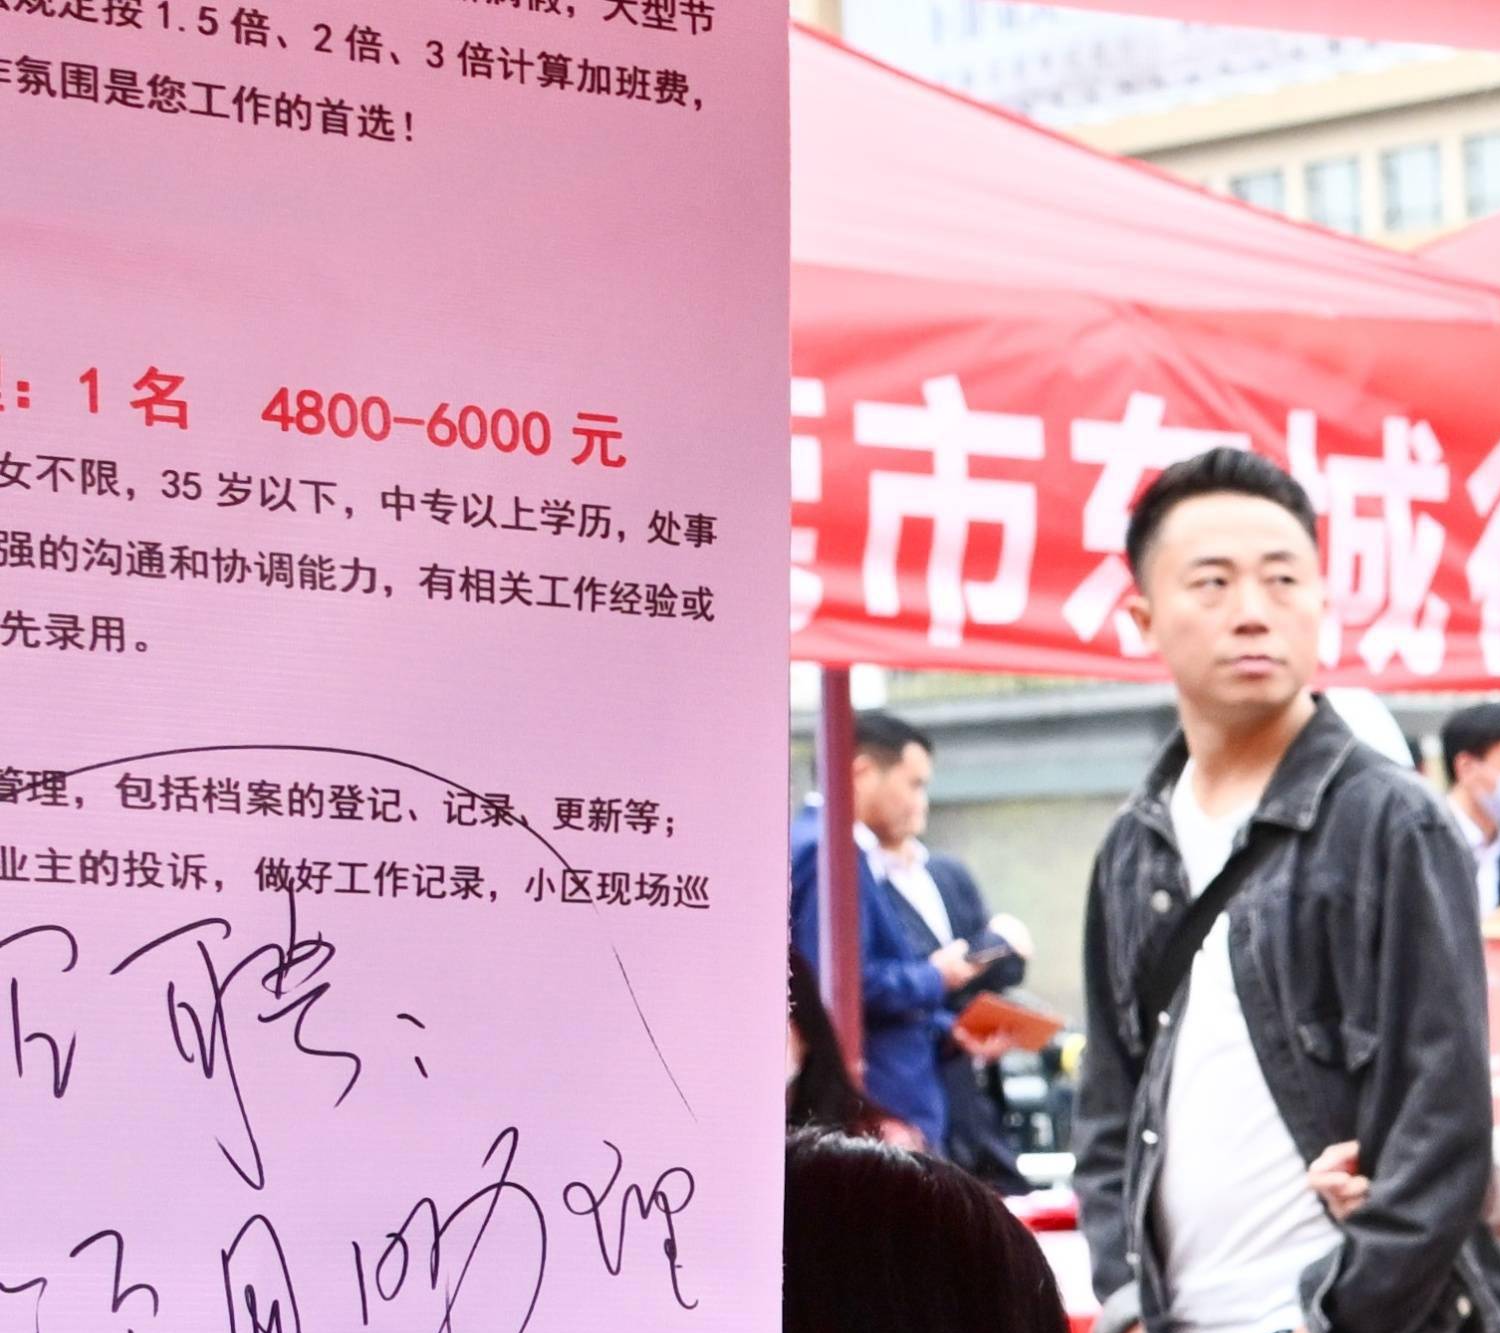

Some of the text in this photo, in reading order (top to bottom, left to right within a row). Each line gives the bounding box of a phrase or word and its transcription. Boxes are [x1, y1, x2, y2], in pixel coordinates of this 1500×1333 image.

[0, 55, 415, 144] 氛围是您工作的首选！
[0, 366, 190, 431] ：1名
[0, 530, 717, 624] 强的沟通和协调能力，有相关工作经验或
[0, 607, 154, 655] 先录用。
